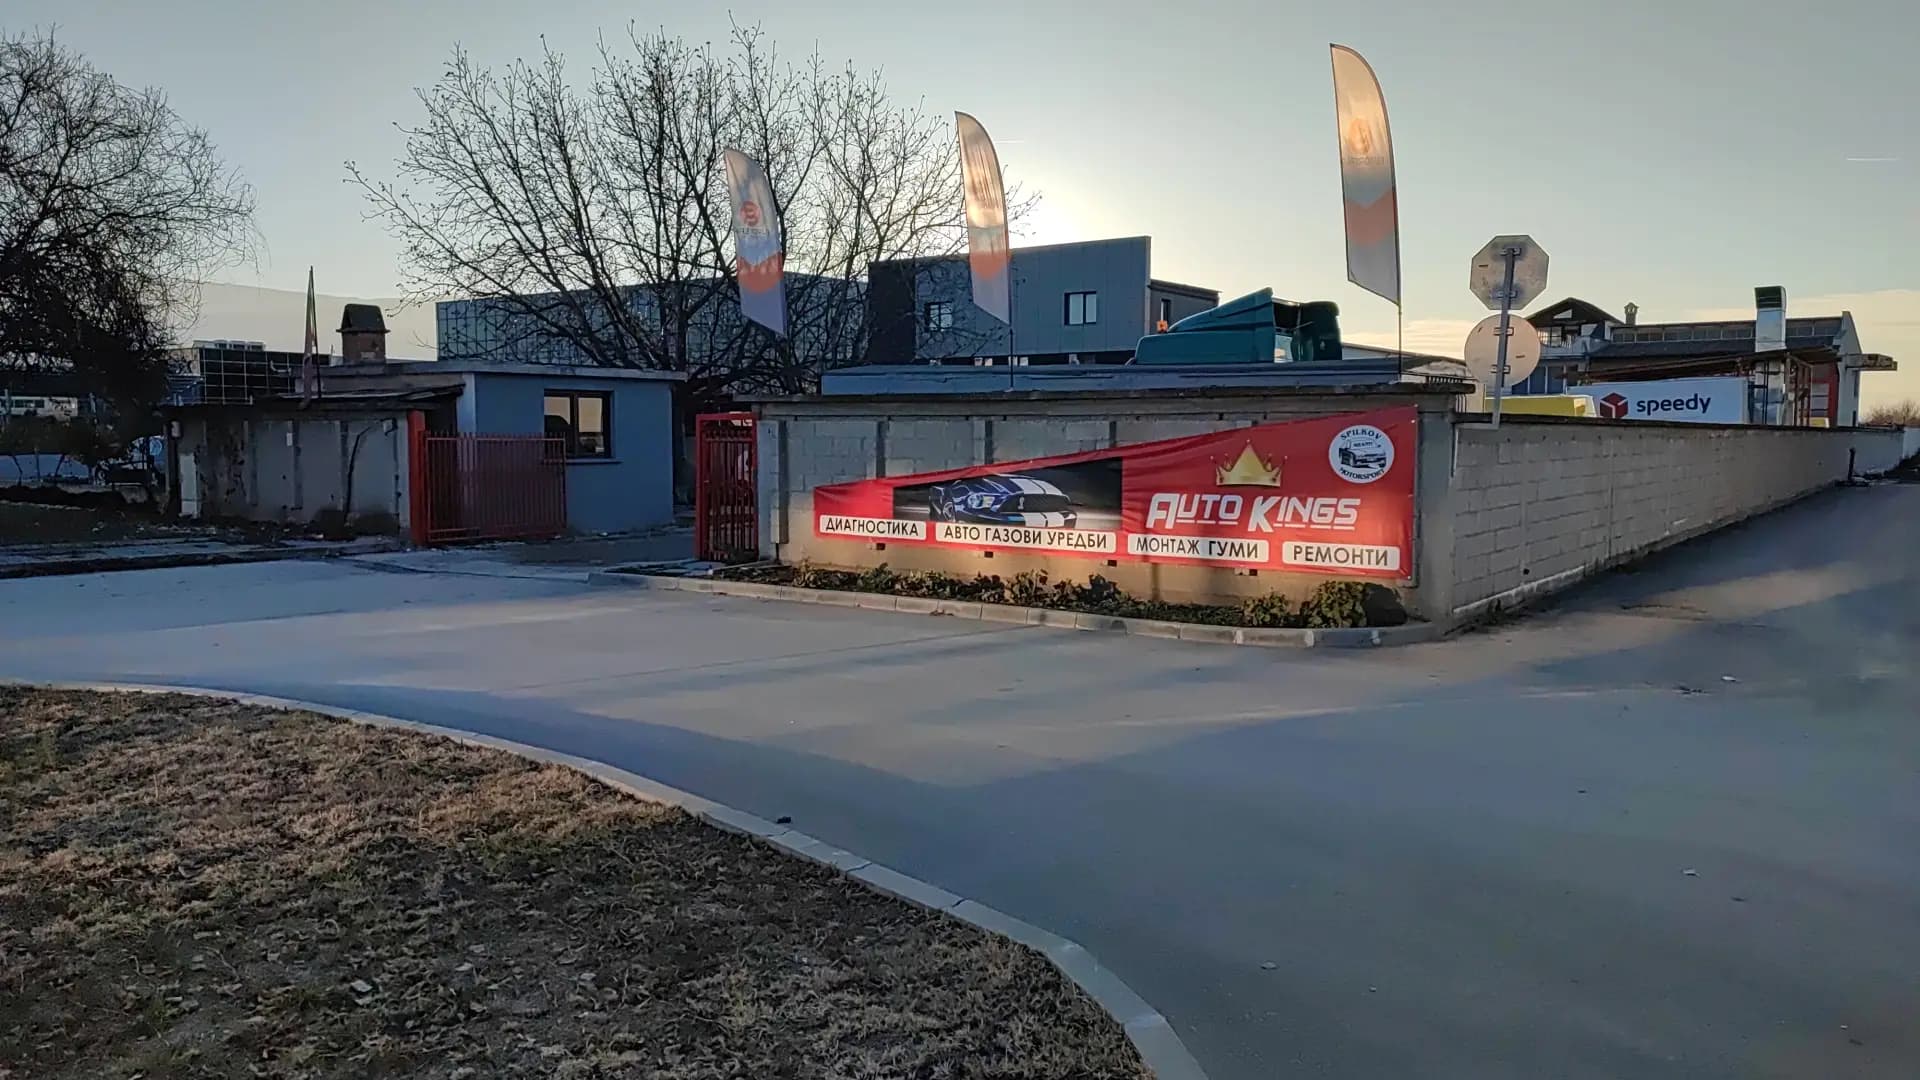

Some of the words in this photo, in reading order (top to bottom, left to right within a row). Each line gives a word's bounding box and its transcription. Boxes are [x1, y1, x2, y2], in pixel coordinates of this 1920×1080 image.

[1636, 393, 1712, 416] speedy
[1340, 428, 1382, 440] SPILKOV
[1145, 492, 1243, 529] AUTO
[1247, 496, 1361, 533] KINGS
[825, 517, 919, 536] ДИАГНОСТИКА
[944, 525, 981, 541] АВТО
[985, 527, 1042, 545] ГАЗОВИ
[1047, 531, 1107, 549] УРЕДБИ
[1136, 537, 1200, 554] МОНТАЖ
[1208, 540, 1258, 558] ГУМИ
[1293, 545, 1388, 566] РЕМОНТИ
